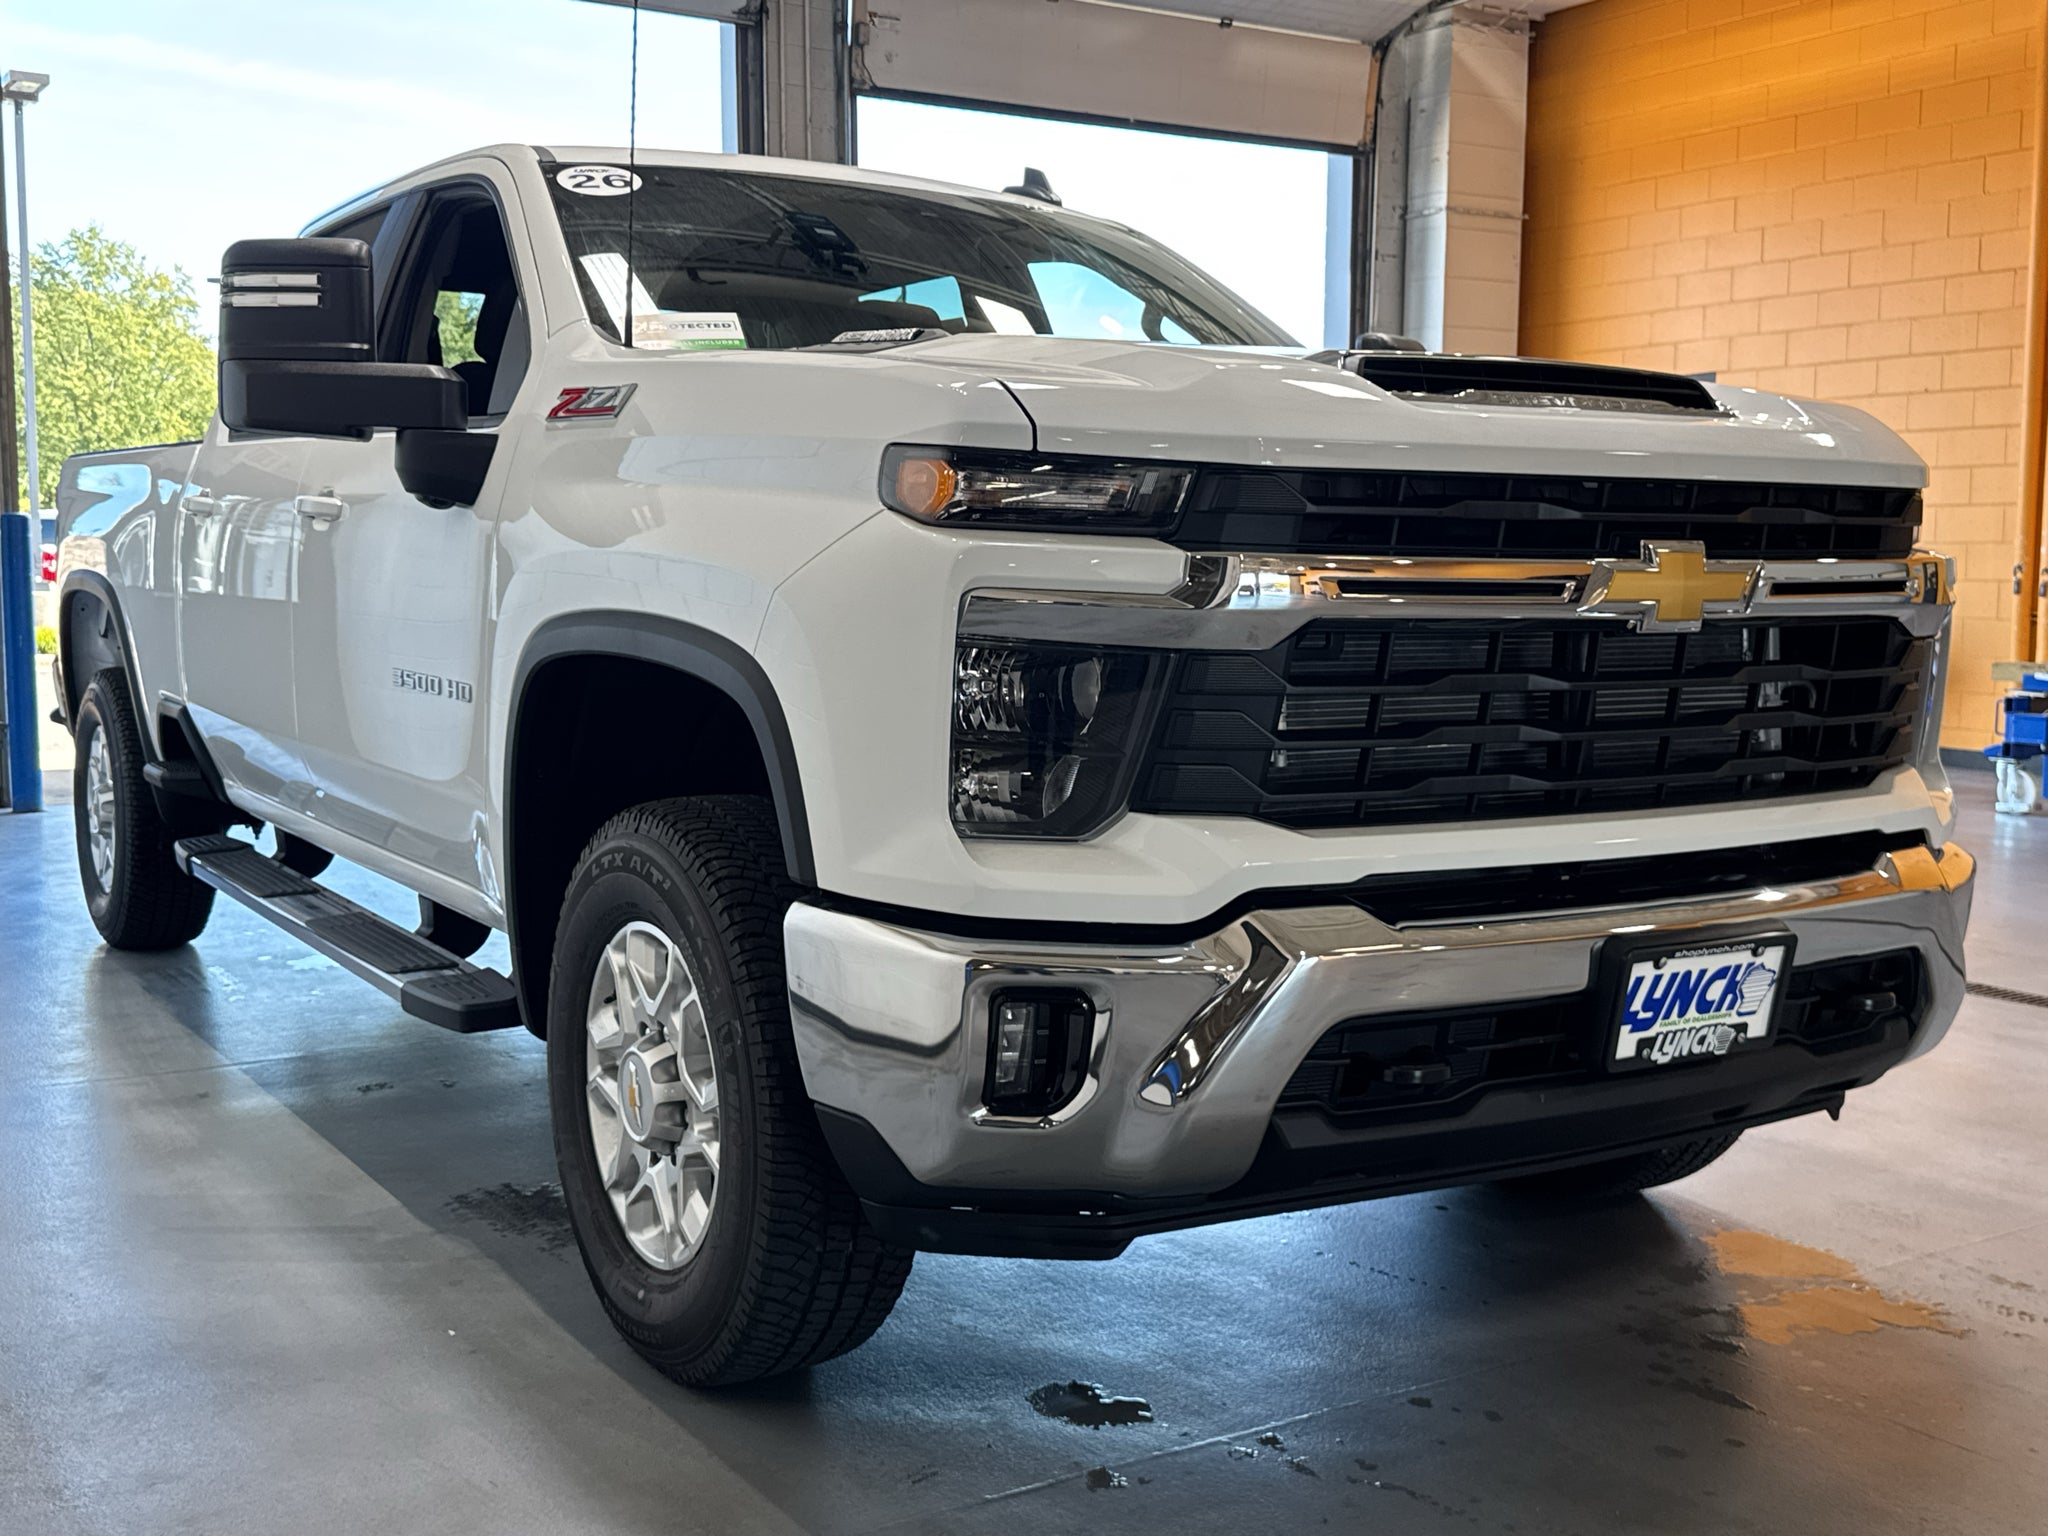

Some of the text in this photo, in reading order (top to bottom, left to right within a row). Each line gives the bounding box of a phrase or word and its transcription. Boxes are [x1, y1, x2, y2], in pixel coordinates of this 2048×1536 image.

[568, 174, 632, 189] 26
[546, 383, 638, 422] Z71
[392, 667, 473, 703] 3500 HD
[592, 852, 624, 878] LTX
[1674, 943, 1755, 958] shoplynch.com
[1622, 961, 1756, 1034] LYNCH
[1650, 1024, 1721, 1065] LYNCH
